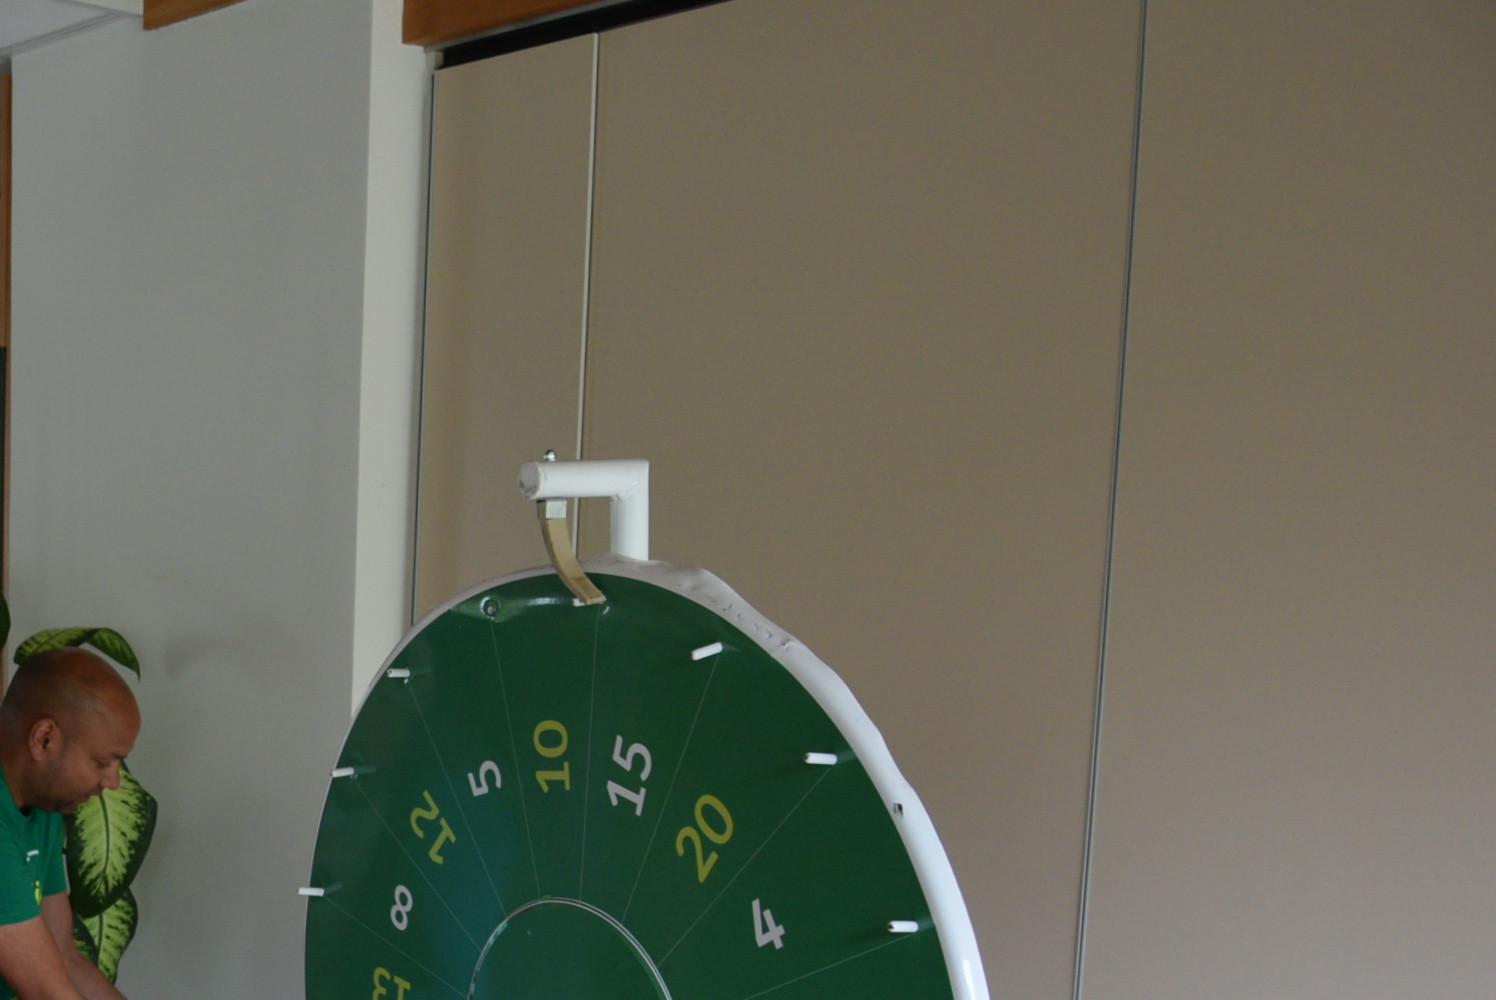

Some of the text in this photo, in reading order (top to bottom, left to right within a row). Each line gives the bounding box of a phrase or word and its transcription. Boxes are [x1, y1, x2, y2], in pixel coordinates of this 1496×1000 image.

[467, 761, 502, 797] 5
[534, 720, 570, 792] 10
[606, 735, 651, 816] 15
[409, 791, 456, 864] 12
[676, 795, 733, 882] 20
[390, 885, 413, 930] 8
[752, 899, 785, 949] 4
